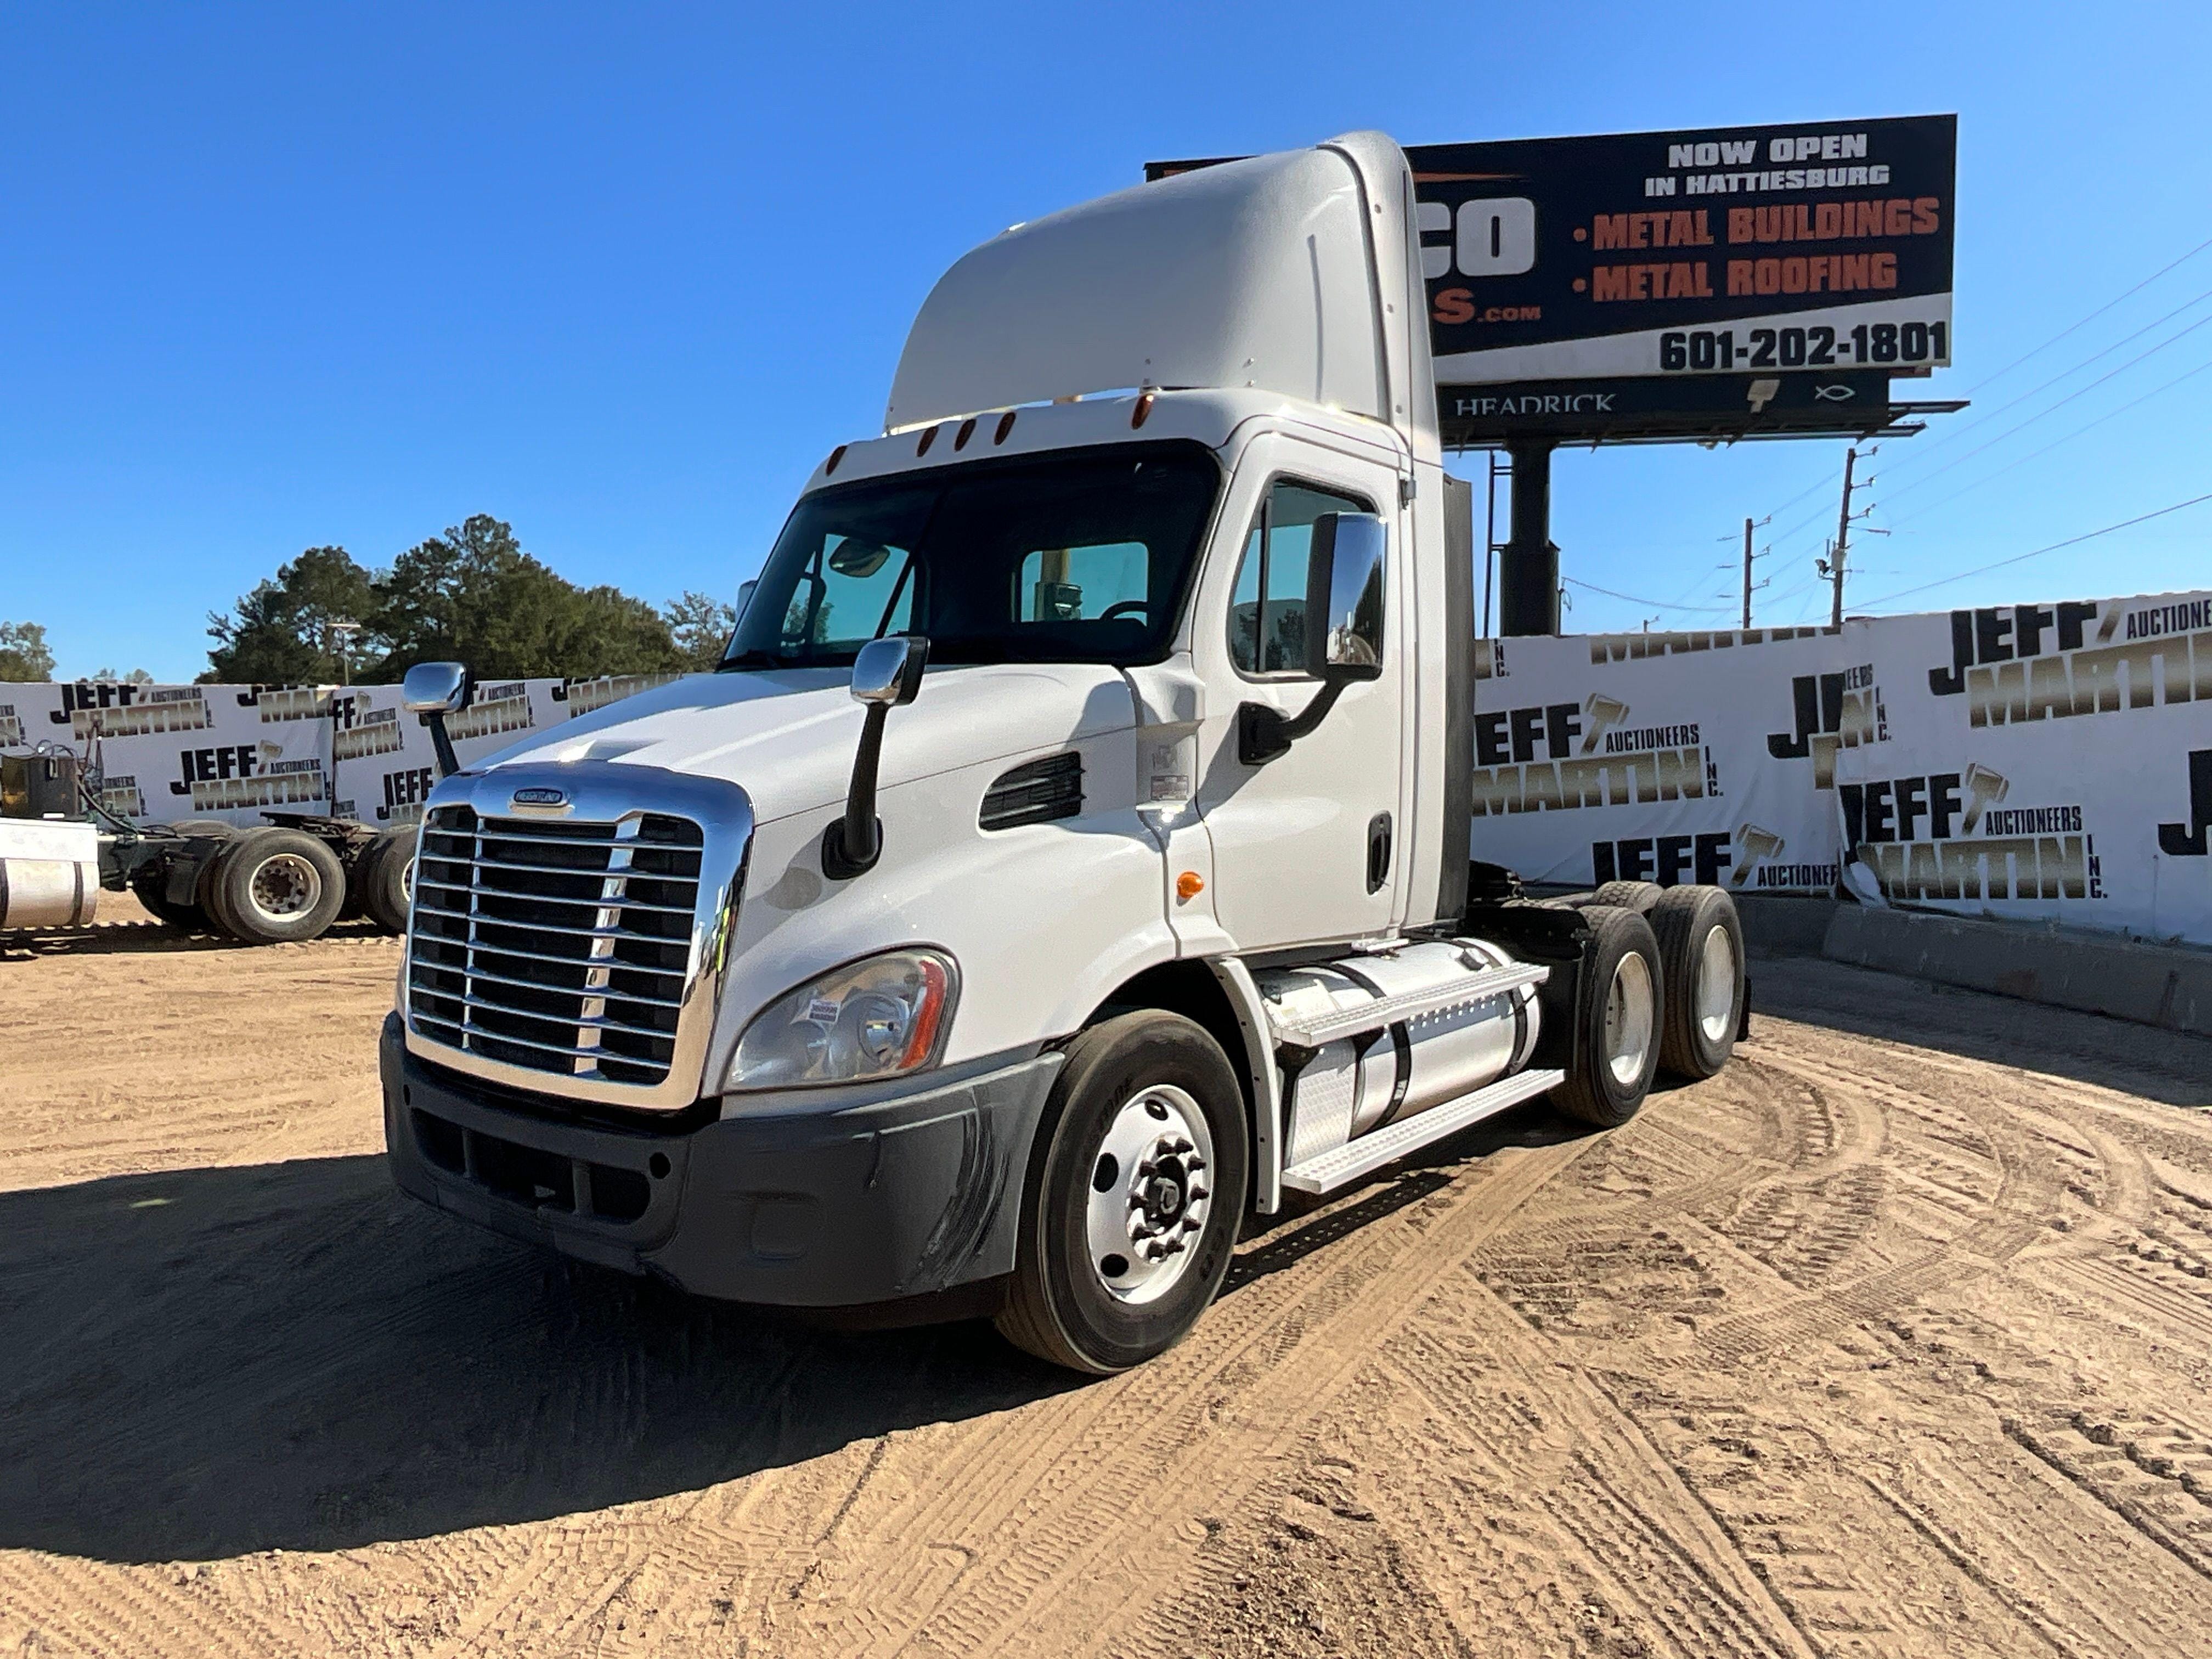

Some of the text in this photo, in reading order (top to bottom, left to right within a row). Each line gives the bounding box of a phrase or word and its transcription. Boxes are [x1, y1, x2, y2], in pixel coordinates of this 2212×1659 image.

[1669, 133, 1867, 168] NOW OPEN
[1645, 165, 1890, 197] IN HATTIESBURG
[1593, 196, 1940, 250] METAL BUILDINGS
[1593, 252, 1898, 302] METAL ROOFING
[1660, 320, 1946, 371] 601-202-1801
[1455, 393, 1616, 416] HEADRICK
[1929, 599, 2212, 695] JEFF AUCTIONE
[50, 684, 138, 724] JEFF
[333, 696, 356, 731] FF
[1473, 703, 1700, 766] EFF AUCTIONEERS
[169, 744, 258, 795] JEFF
[376, 767, 433, 820] JEFF
[1839, 772, 2083, 866] JEFF AUCTIONEERS
